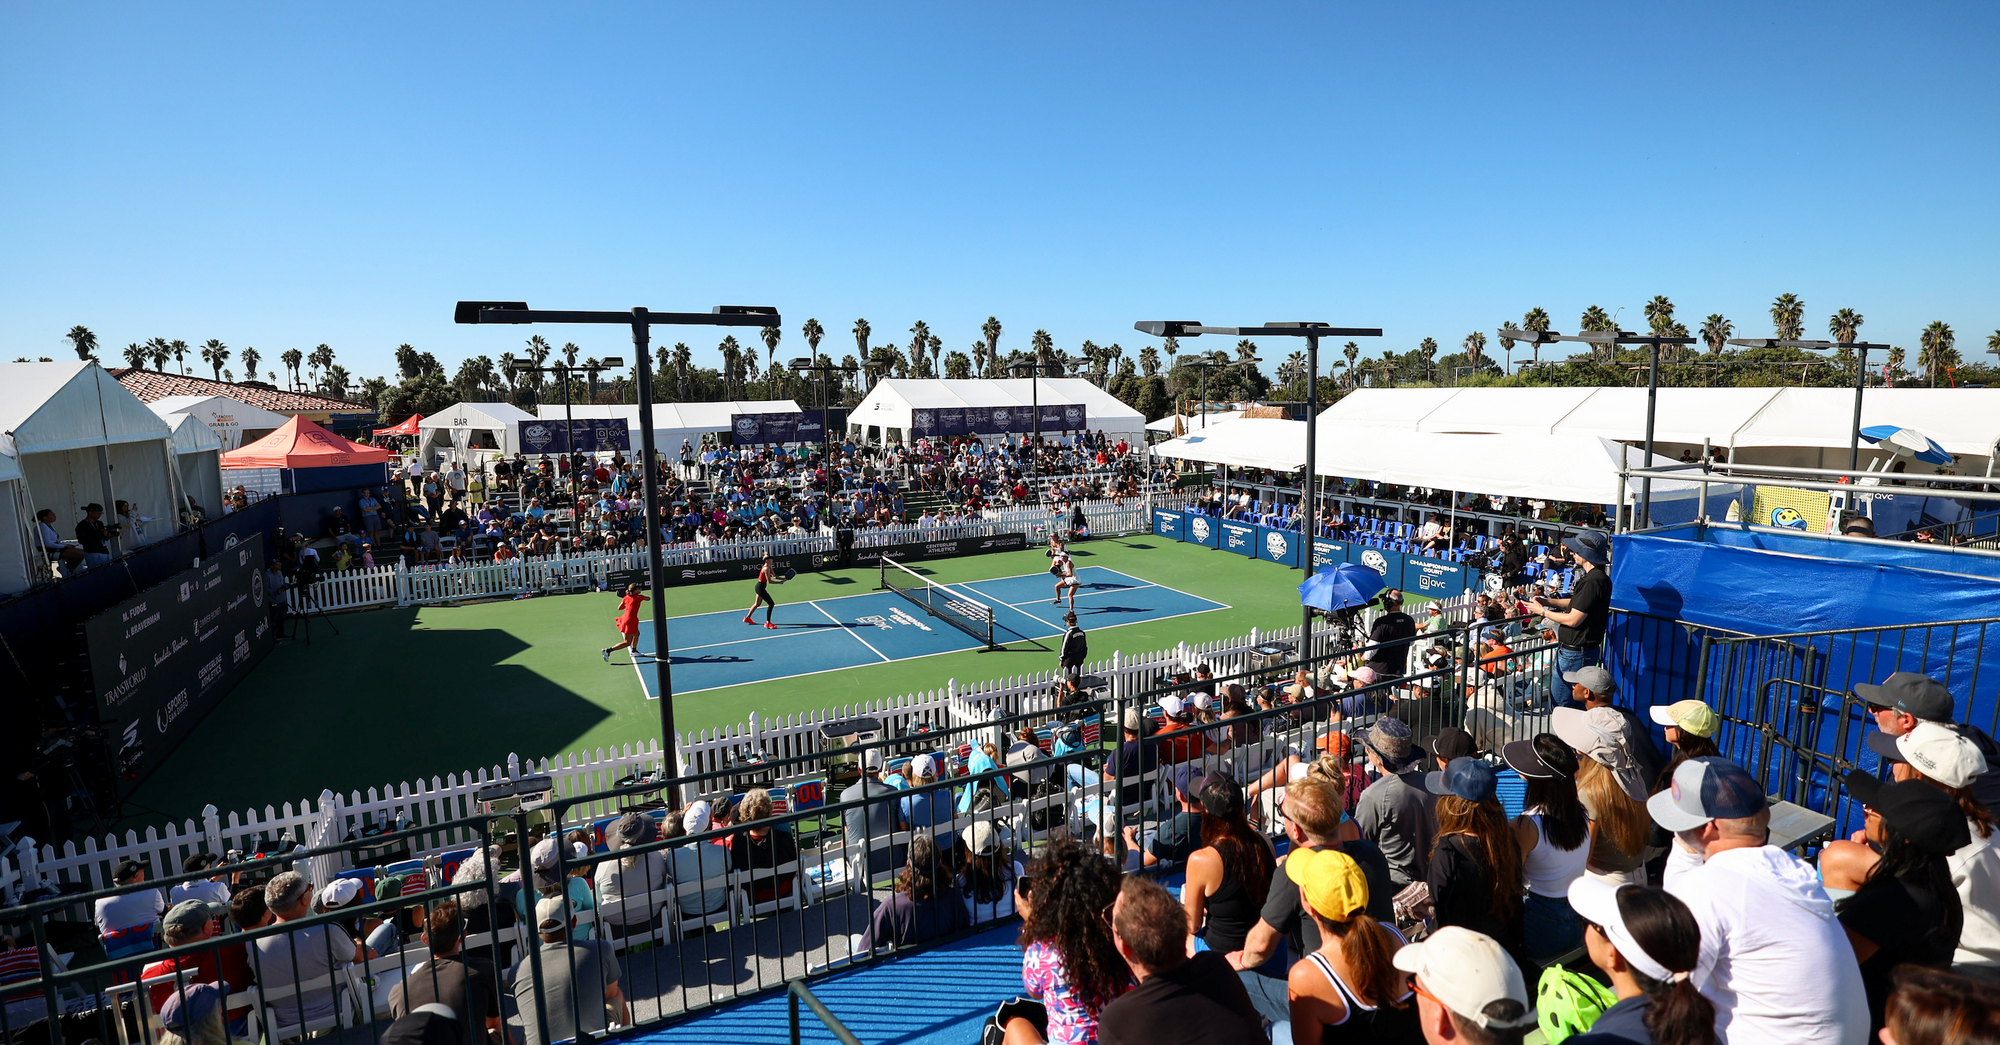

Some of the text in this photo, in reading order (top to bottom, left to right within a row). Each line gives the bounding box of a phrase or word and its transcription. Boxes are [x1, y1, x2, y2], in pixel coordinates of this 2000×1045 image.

[749, 561, 790, 570] PICETILE
[1320, 557, 1332, 565] QVC
[1409, 559, 1458, 573] CHAMPIONSHIP
[1423, 567, 1444, 575] COURT
[1431, 580, 1446, 589] QVC
[129, 602, 148, 619] FUDGE
[131, 611, 161, 635] BRAVERMAN
[198, 653, 223, 680] CENTERLINE
[200, 663, 222, 689] ATHLETICS
[104, 666, 148, 707] TRANSWORLD
[166, 688, 188, 714] SPORTS
[176, 700, 189, 717] DIEGO
